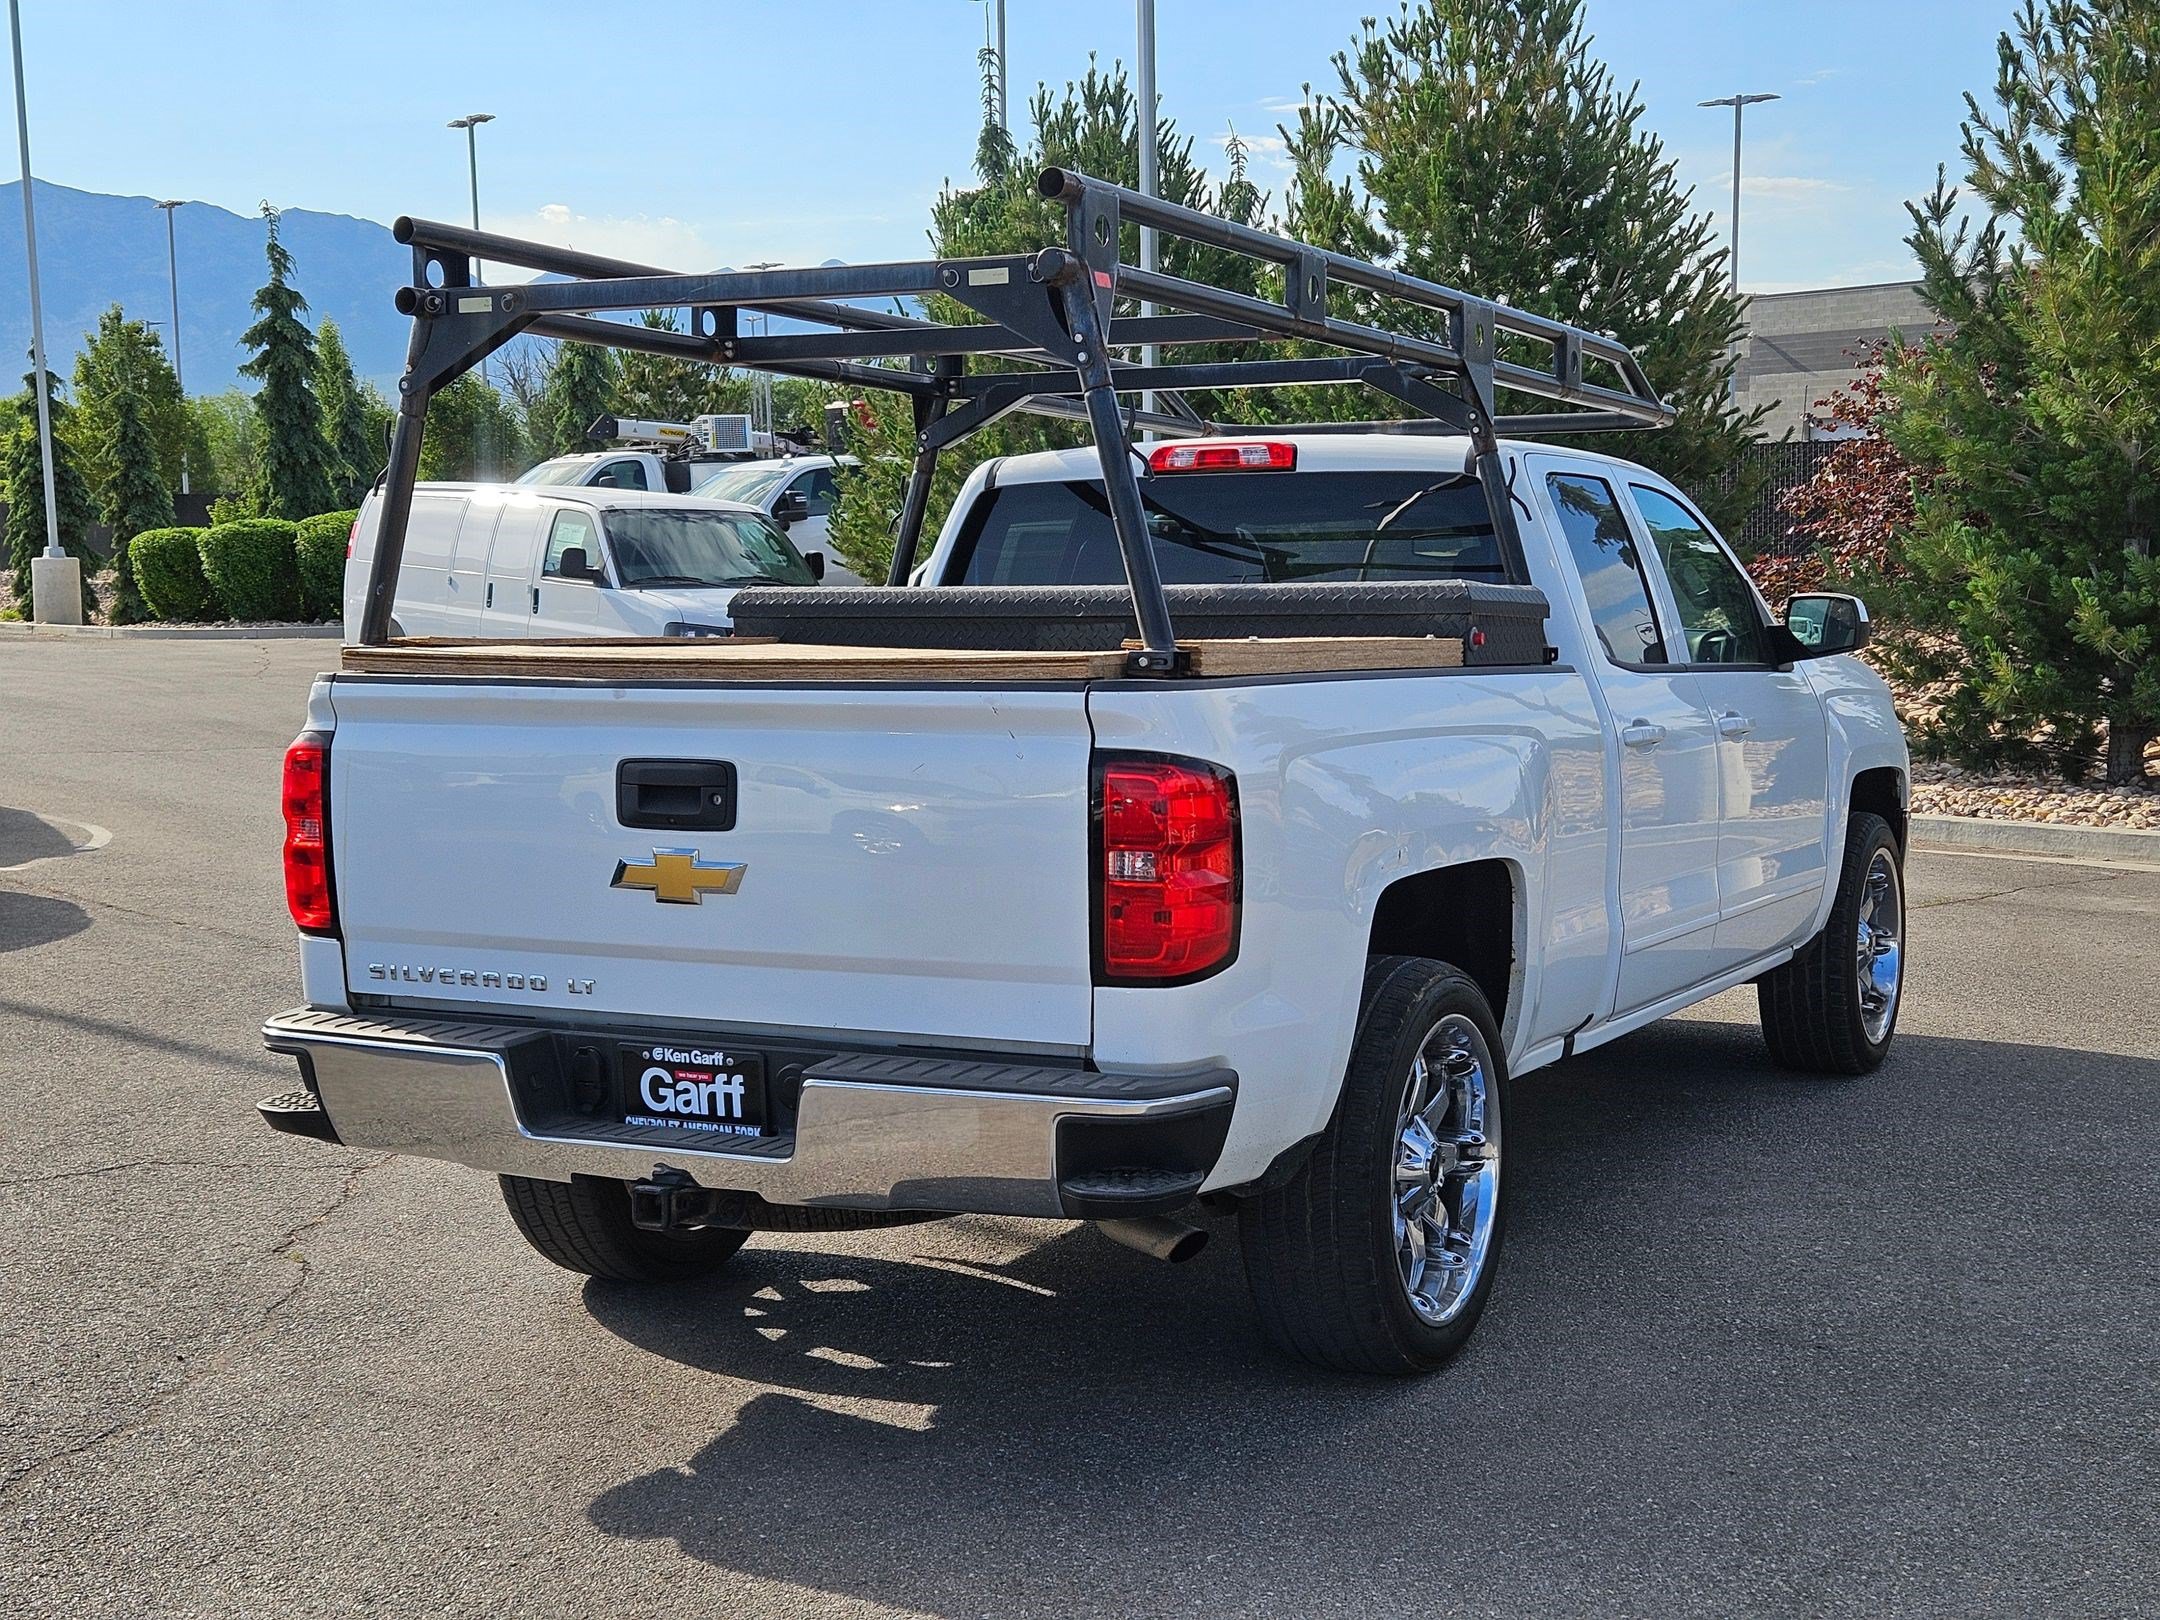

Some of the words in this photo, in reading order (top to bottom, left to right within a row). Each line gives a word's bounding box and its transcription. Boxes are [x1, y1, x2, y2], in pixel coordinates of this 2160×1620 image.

[368, 962, 548, 992] SILVERADO
[567, 978, 596, 995] LT
[664, 1048, 690, 1064] Ken
[690, 1050, 724, 1066] Garff
[640, 1066, 745, 1118] Garff
